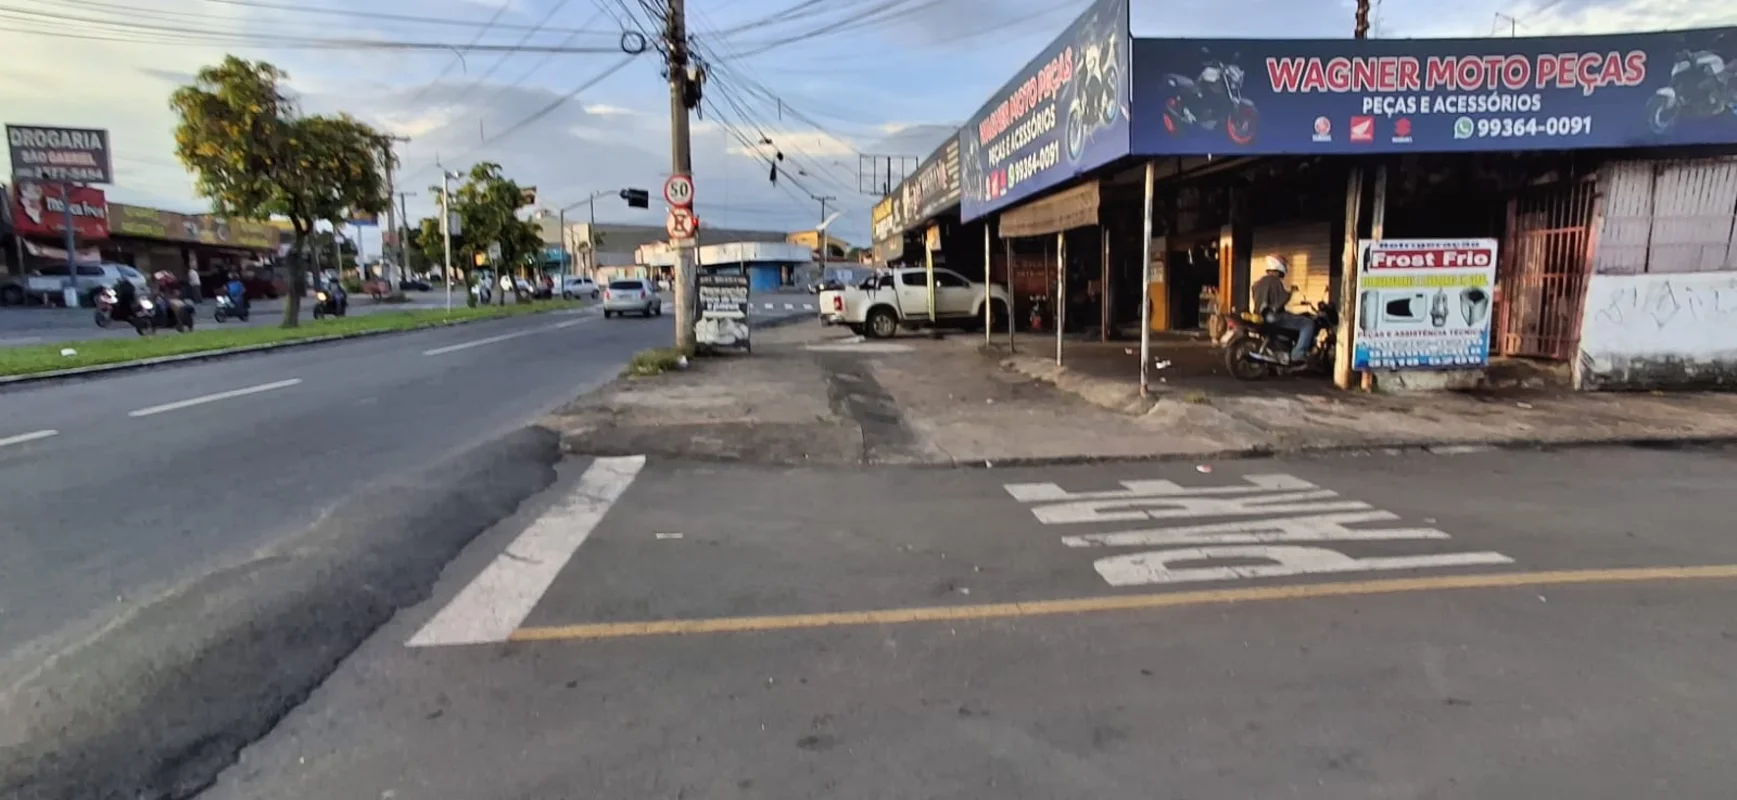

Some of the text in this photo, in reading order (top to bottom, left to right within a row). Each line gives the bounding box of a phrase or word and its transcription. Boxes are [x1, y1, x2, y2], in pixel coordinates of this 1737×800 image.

[1009, 76, 1038, 122] MOTO
[1038, 46, 1073, 101] PEÇAS
[1266, 51, 1647, 95] WAGNER MOTO PEÇAS
[1363, 91, 1541, 117] PEÇAS E ACESSÓRIOS
[9, 127, 102, 149] DROGARIA
[1011, 103, 1056, 152] ACESSÓRIOS
[1477, 116, 1592, 137] 99364-0091
[1014, 139, 1060, 184] 99364-0091
[670, 182, 689, 198] 50
[1372, 250, 1489, 267] Frost Frio
[1004, 474, 1514, 586] PARE
